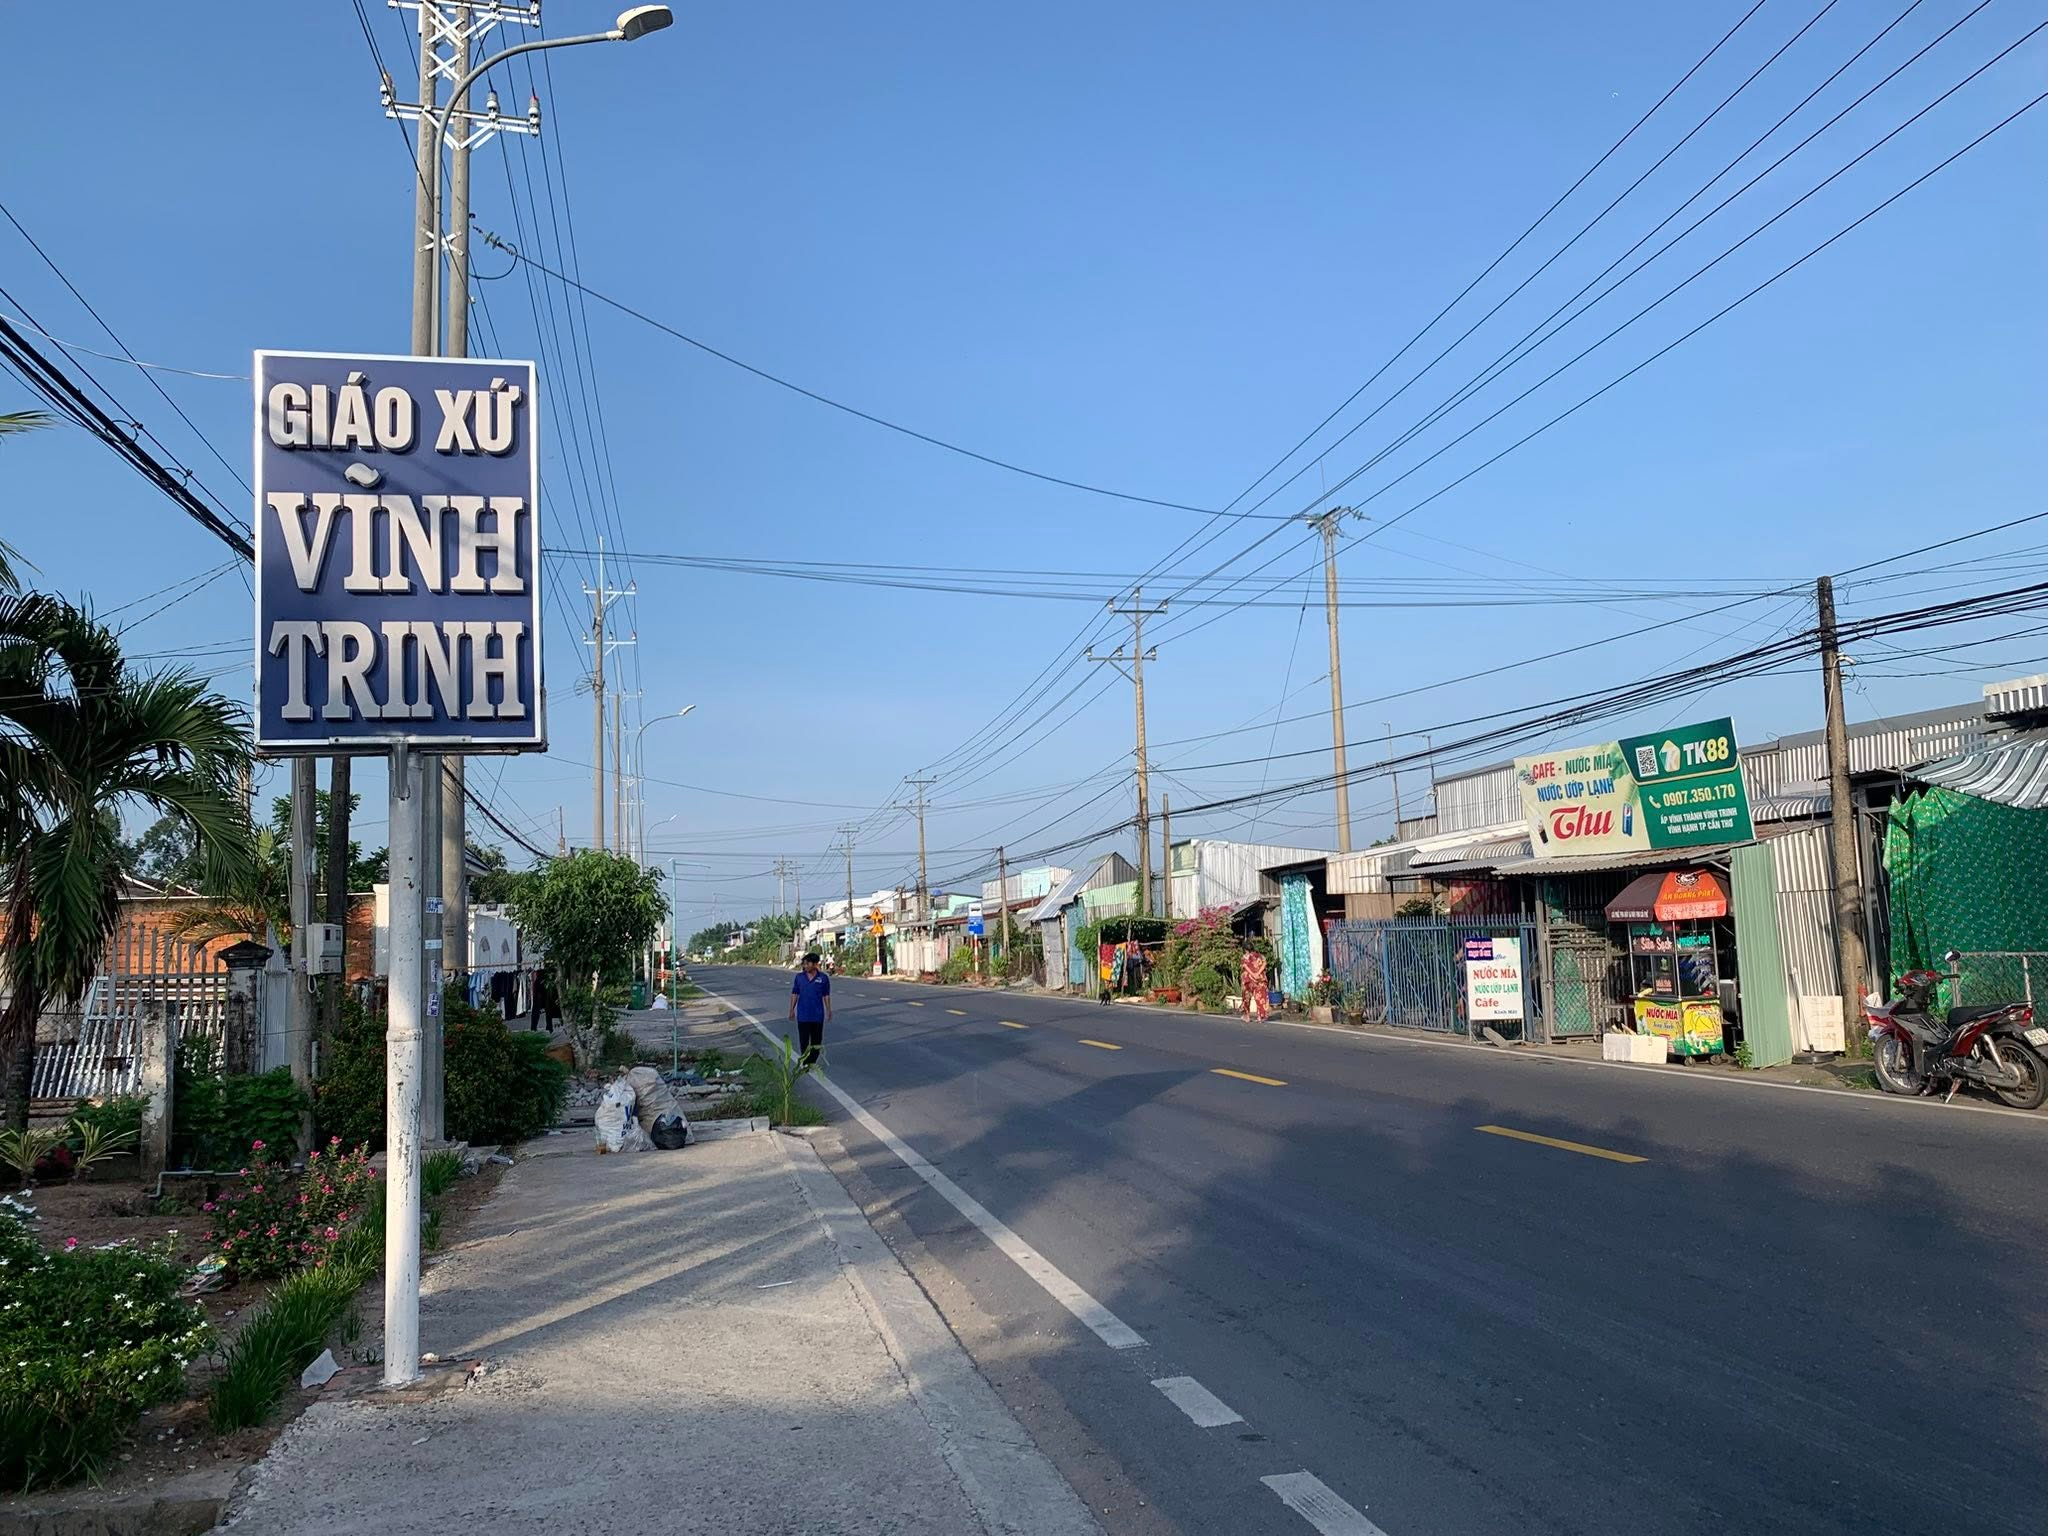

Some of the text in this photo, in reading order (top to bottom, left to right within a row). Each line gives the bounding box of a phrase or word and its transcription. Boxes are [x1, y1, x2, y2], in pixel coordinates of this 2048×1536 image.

[268, 371, 521, 455] GIÁO XỨ
[267, 462, 525, 593] VĨNH
[267, 620, 525, 720] TRINH
[1532, 761, 1555, 780] CAFE
[1565, 755, 1591, 775] NƯỚC
[1593, 751, 1612, 771] MÍA
[1683, 736, 1729, 766] TK88
[1537, 777, 1615, 802] NƯỚC ƯỚP LẠNH
[1663, 783, 1736, 807] 0907.350.170
[1549, 804, 1615, 840] Thu
[1473, 965, 1517, 980] NƯỚC MÍA
